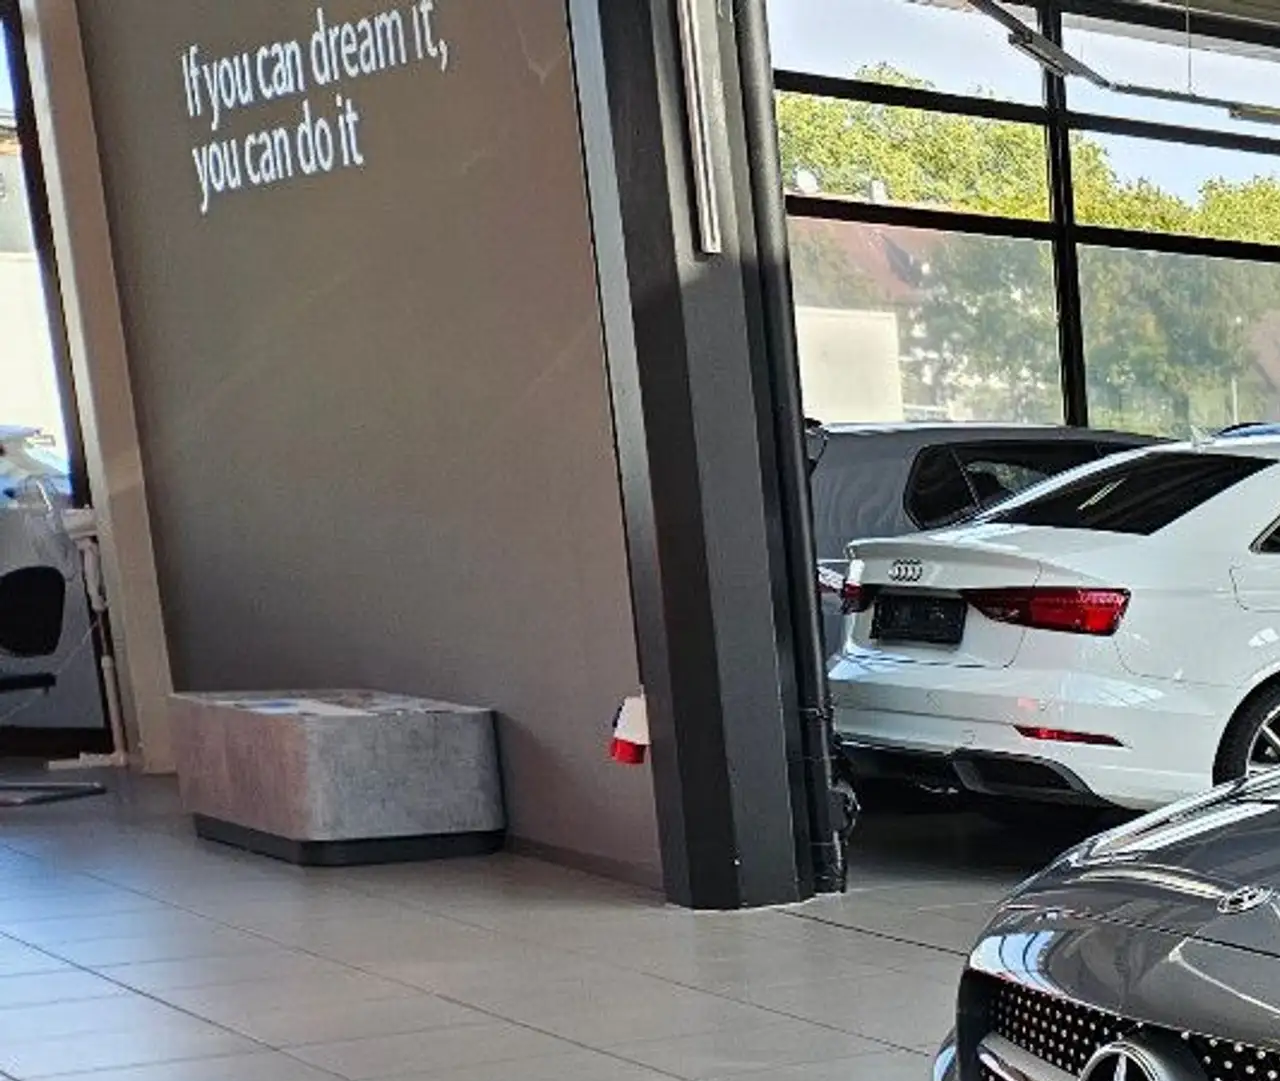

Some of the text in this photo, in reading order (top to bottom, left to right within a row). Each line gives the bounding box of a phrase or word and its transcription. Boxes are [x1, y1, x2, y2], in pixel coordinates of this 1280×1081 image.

[180, 0, 449, 131] If you can dream it,
[191, 92, 365, 214] you can do it
